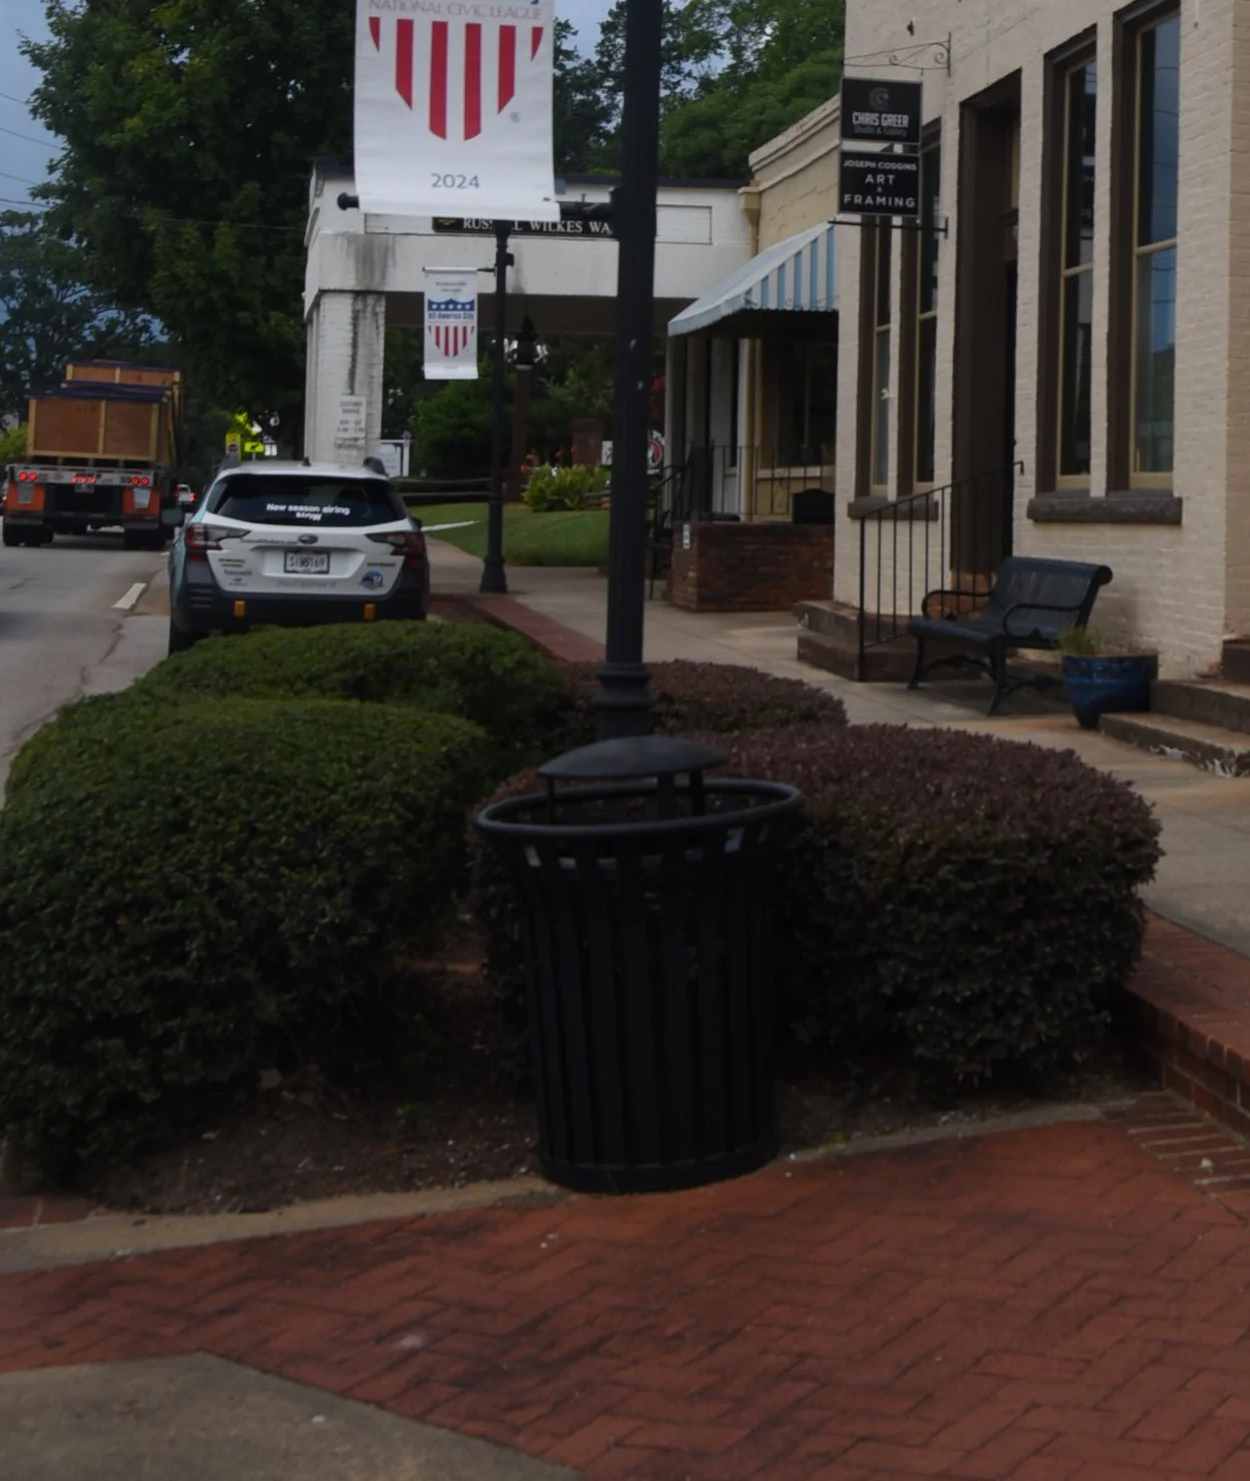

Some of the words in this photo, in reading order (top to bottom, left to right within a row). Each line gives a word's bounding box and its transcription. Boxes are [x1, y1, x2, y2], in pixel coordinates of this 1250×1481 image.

[446, 3, 486, 17] CIVIC
[489, 5, 544, 19] LEAGUE
[852, 111, 879, 126] CHRIS
[881, 113, 909, 128] GREER
[843, 159, 876, 168] JOSEPH
[431, 172, 480, 189] 2024
[865, 174, 896, 185] ART
[843, 194, 915, 208] FRAMING
[462, 218, 523, 231] RUSL
[530, 221, 584, 233] WILKES
[266, 503, 286, 511] New
[288, 504, 320, 512] season
